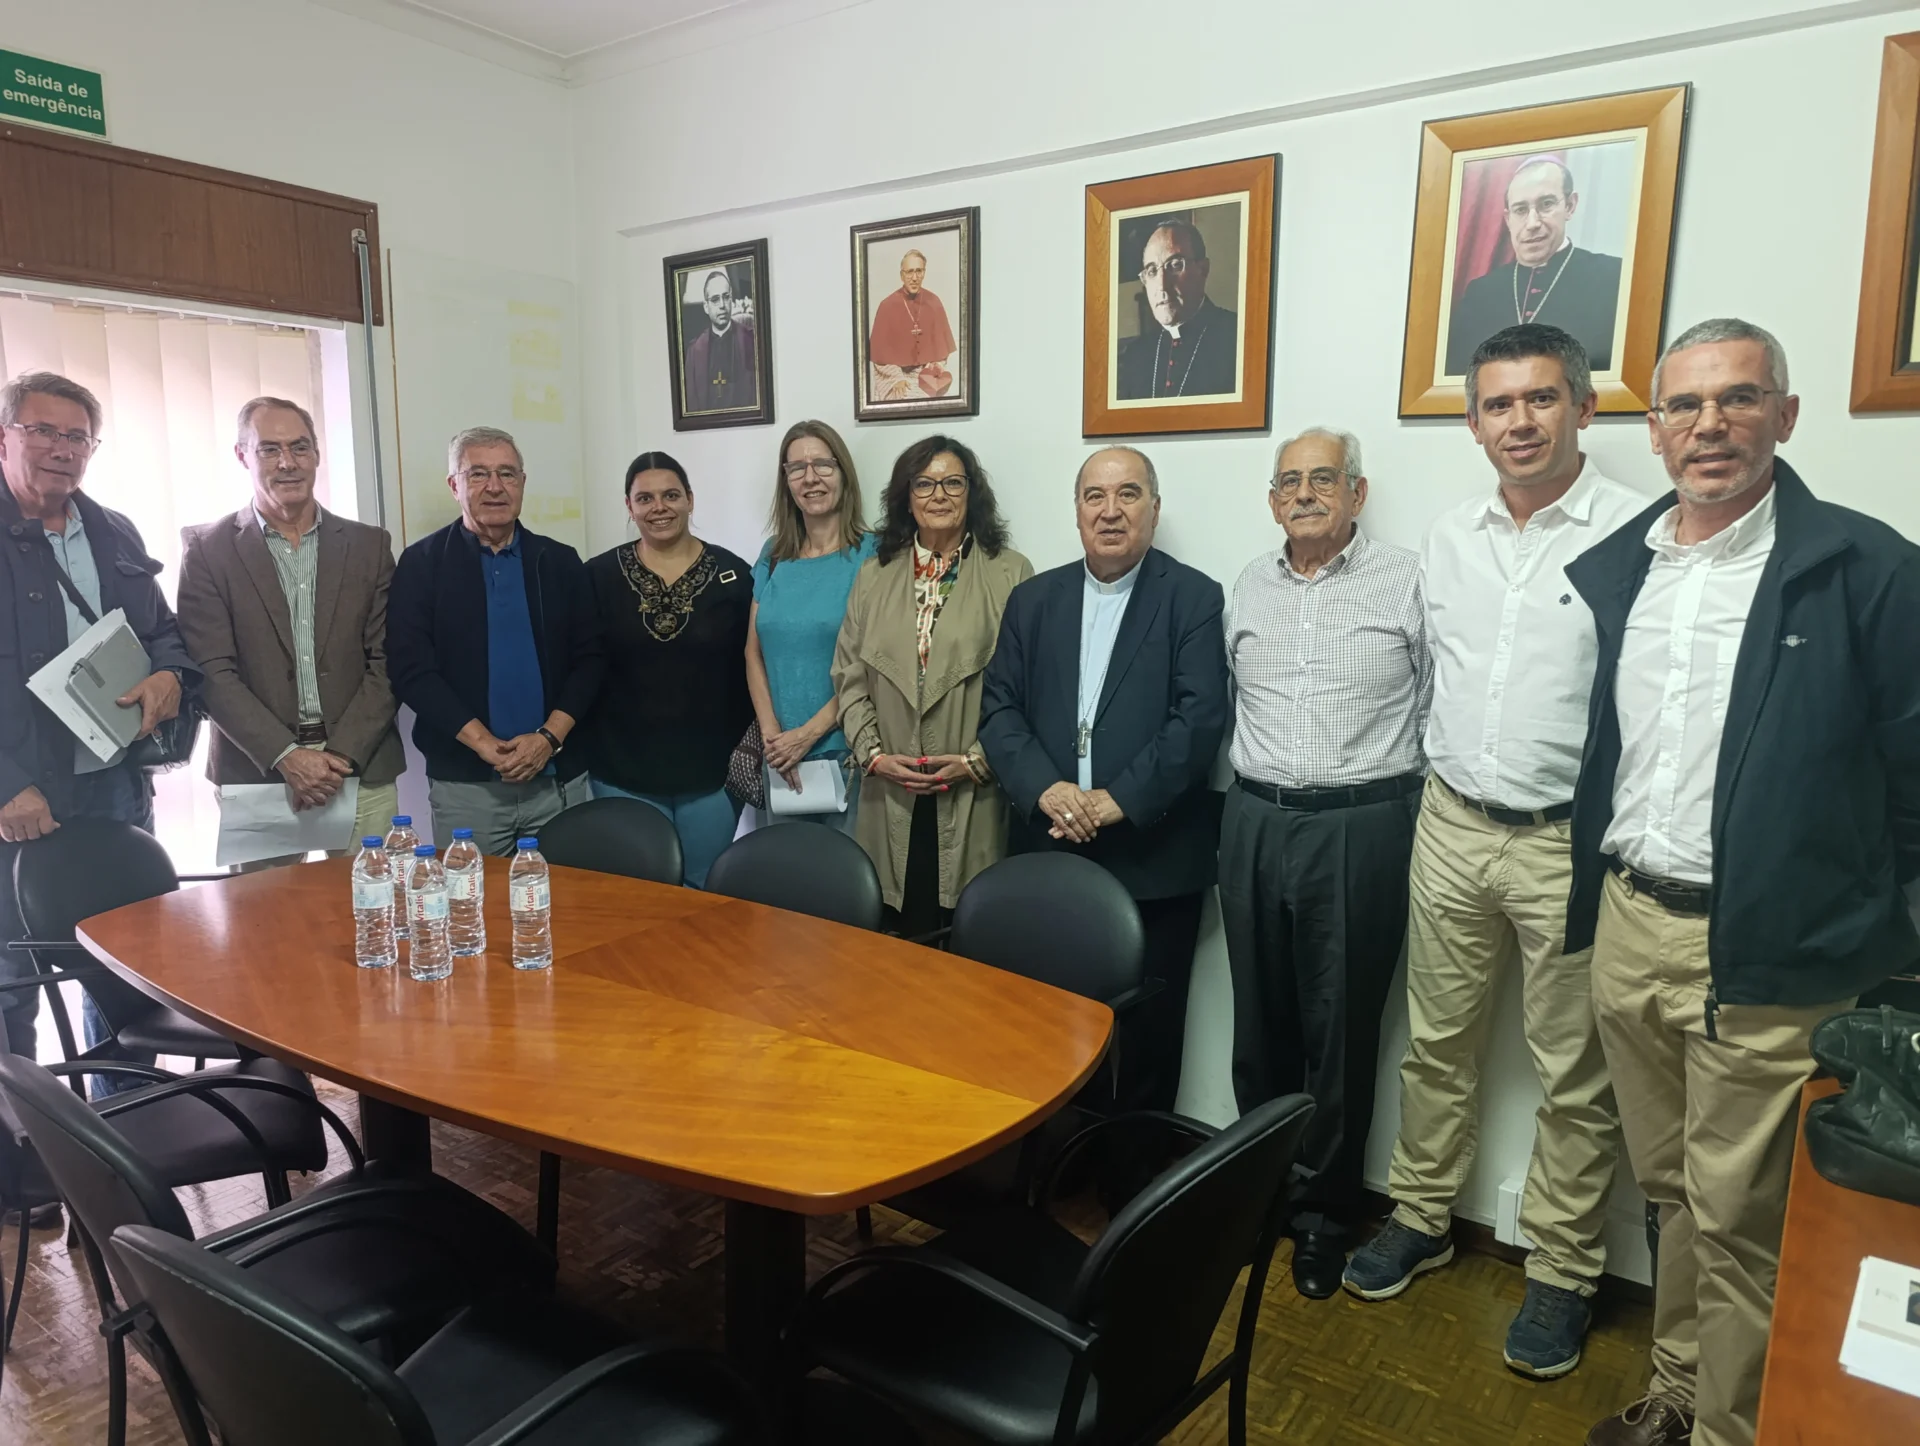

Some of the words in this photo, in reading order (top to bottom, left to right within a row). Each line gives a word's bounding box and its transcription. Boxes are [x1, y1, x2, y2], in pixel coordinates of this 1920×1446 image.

[14, 68, 63, 93] Saída
[67, 83, 88, 98] de
[3, 88, 102, 120] emergência
[415, 894, 425, 921] Vitalis
[524, 885, 535, 912] Vitalis
